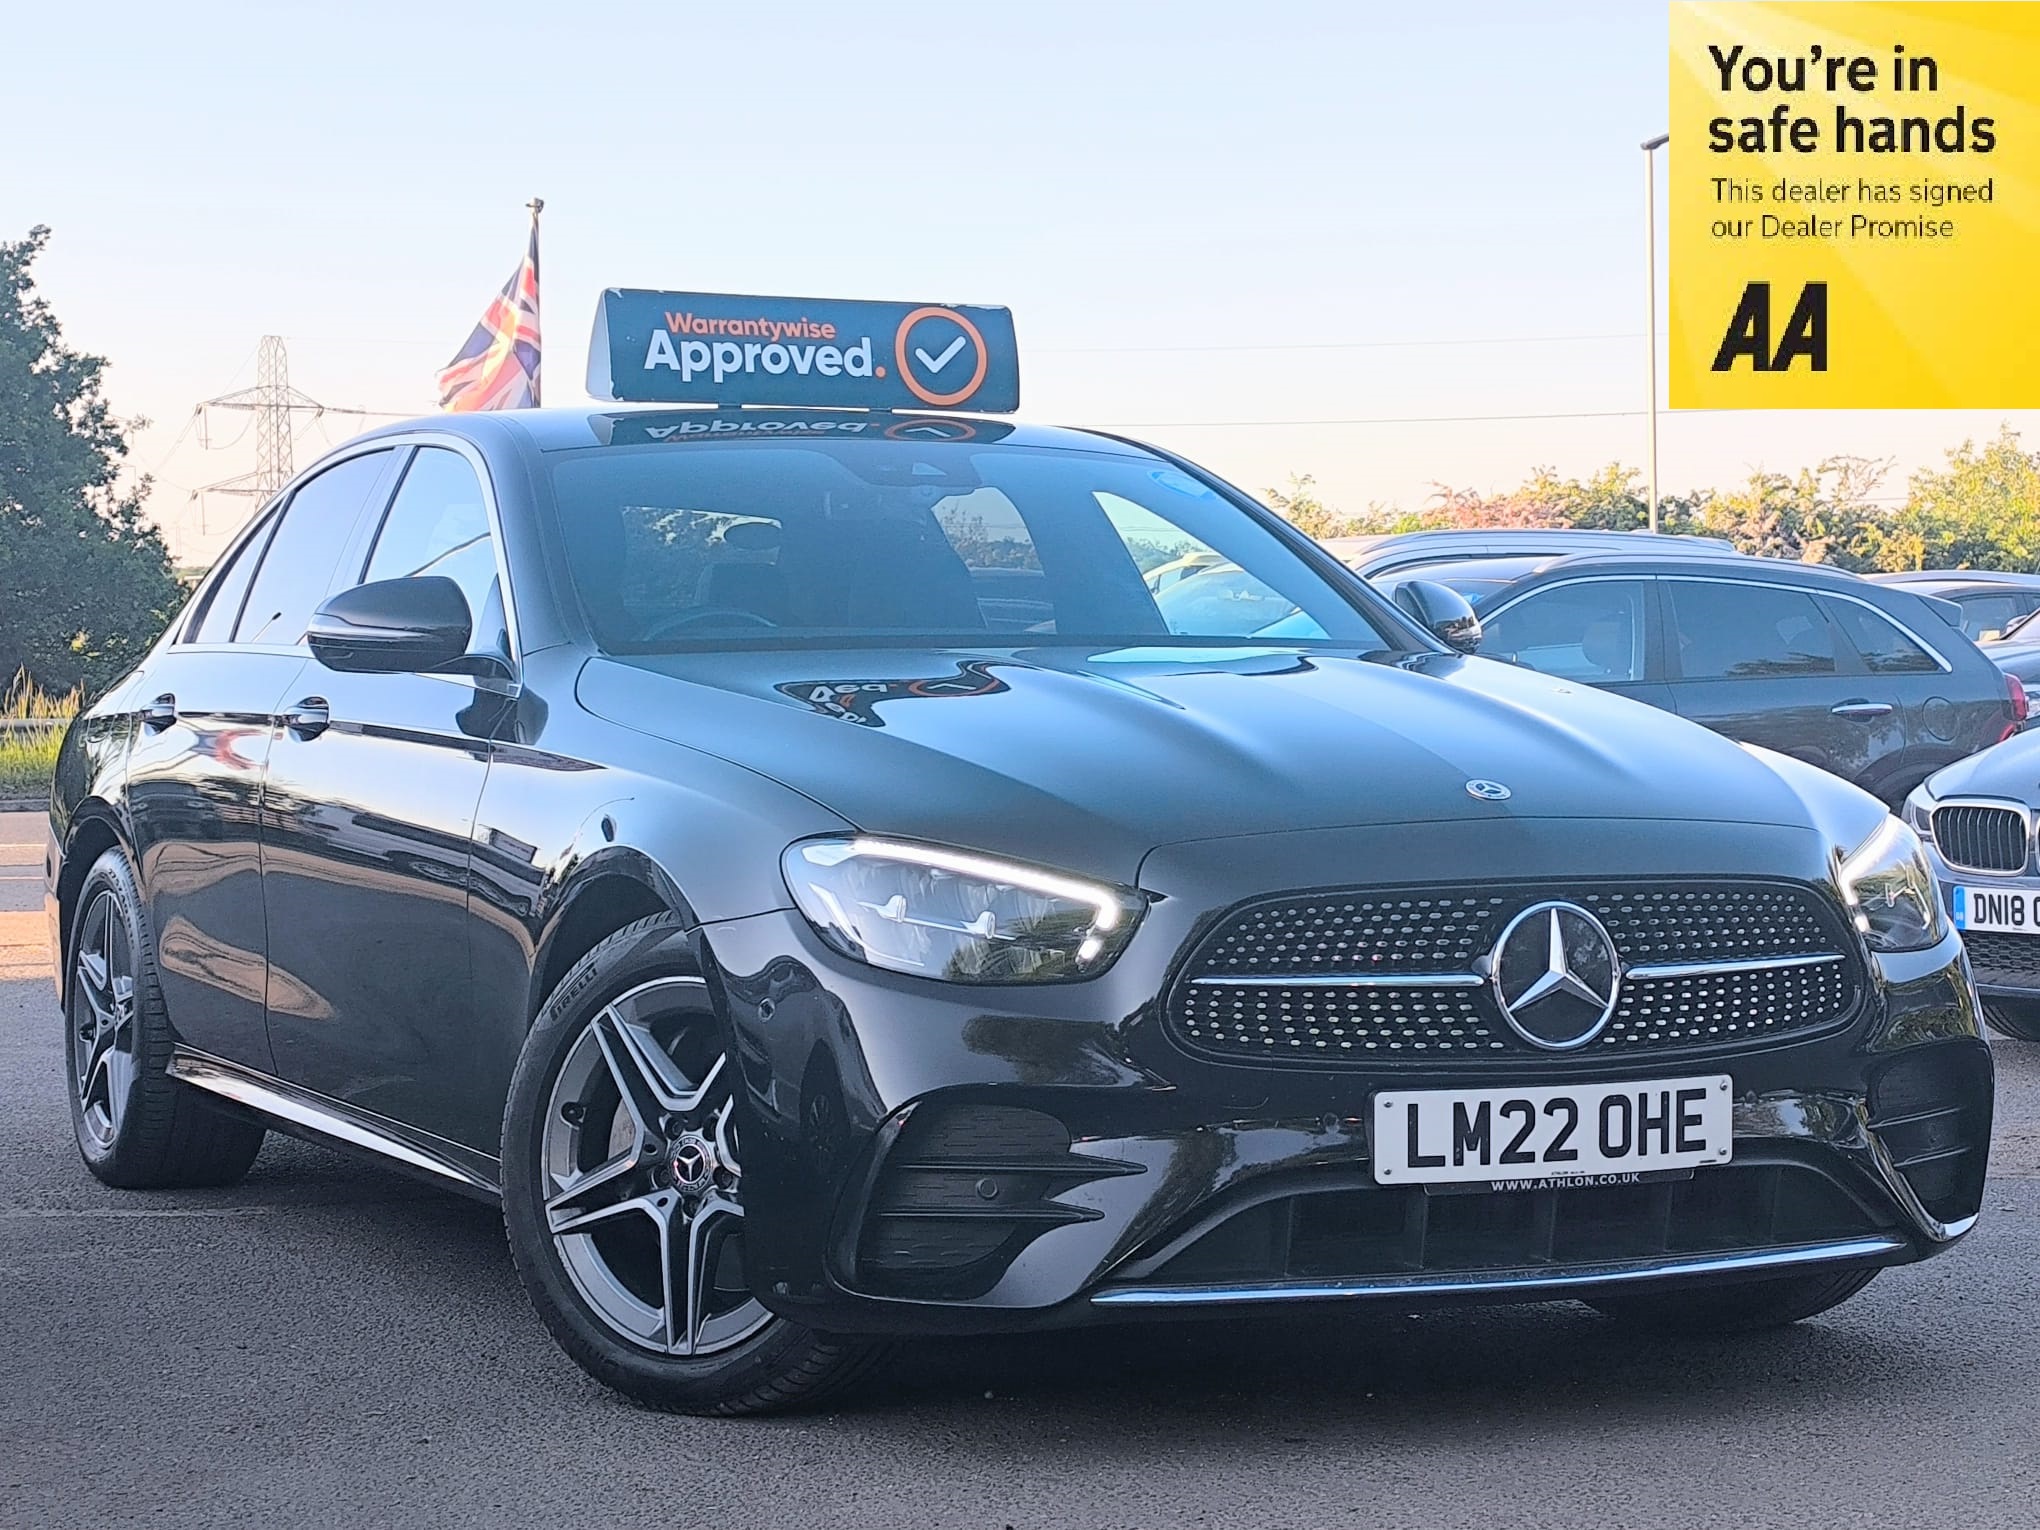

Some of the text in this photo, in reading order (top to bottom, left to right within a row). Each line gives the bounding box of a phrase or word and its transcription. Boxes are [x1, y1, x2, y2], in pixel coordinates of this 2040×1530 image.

[664, 311, 836, 342] Warrantywise
[644, 329, 886, 383] Approved.
[1973, 893, 2025, 926] DN18
[1407, 1087, 1707, 1169] LM22 OHE
[1491, 1172, 1640, 1192] WWW.ATHLON.CO.UK
